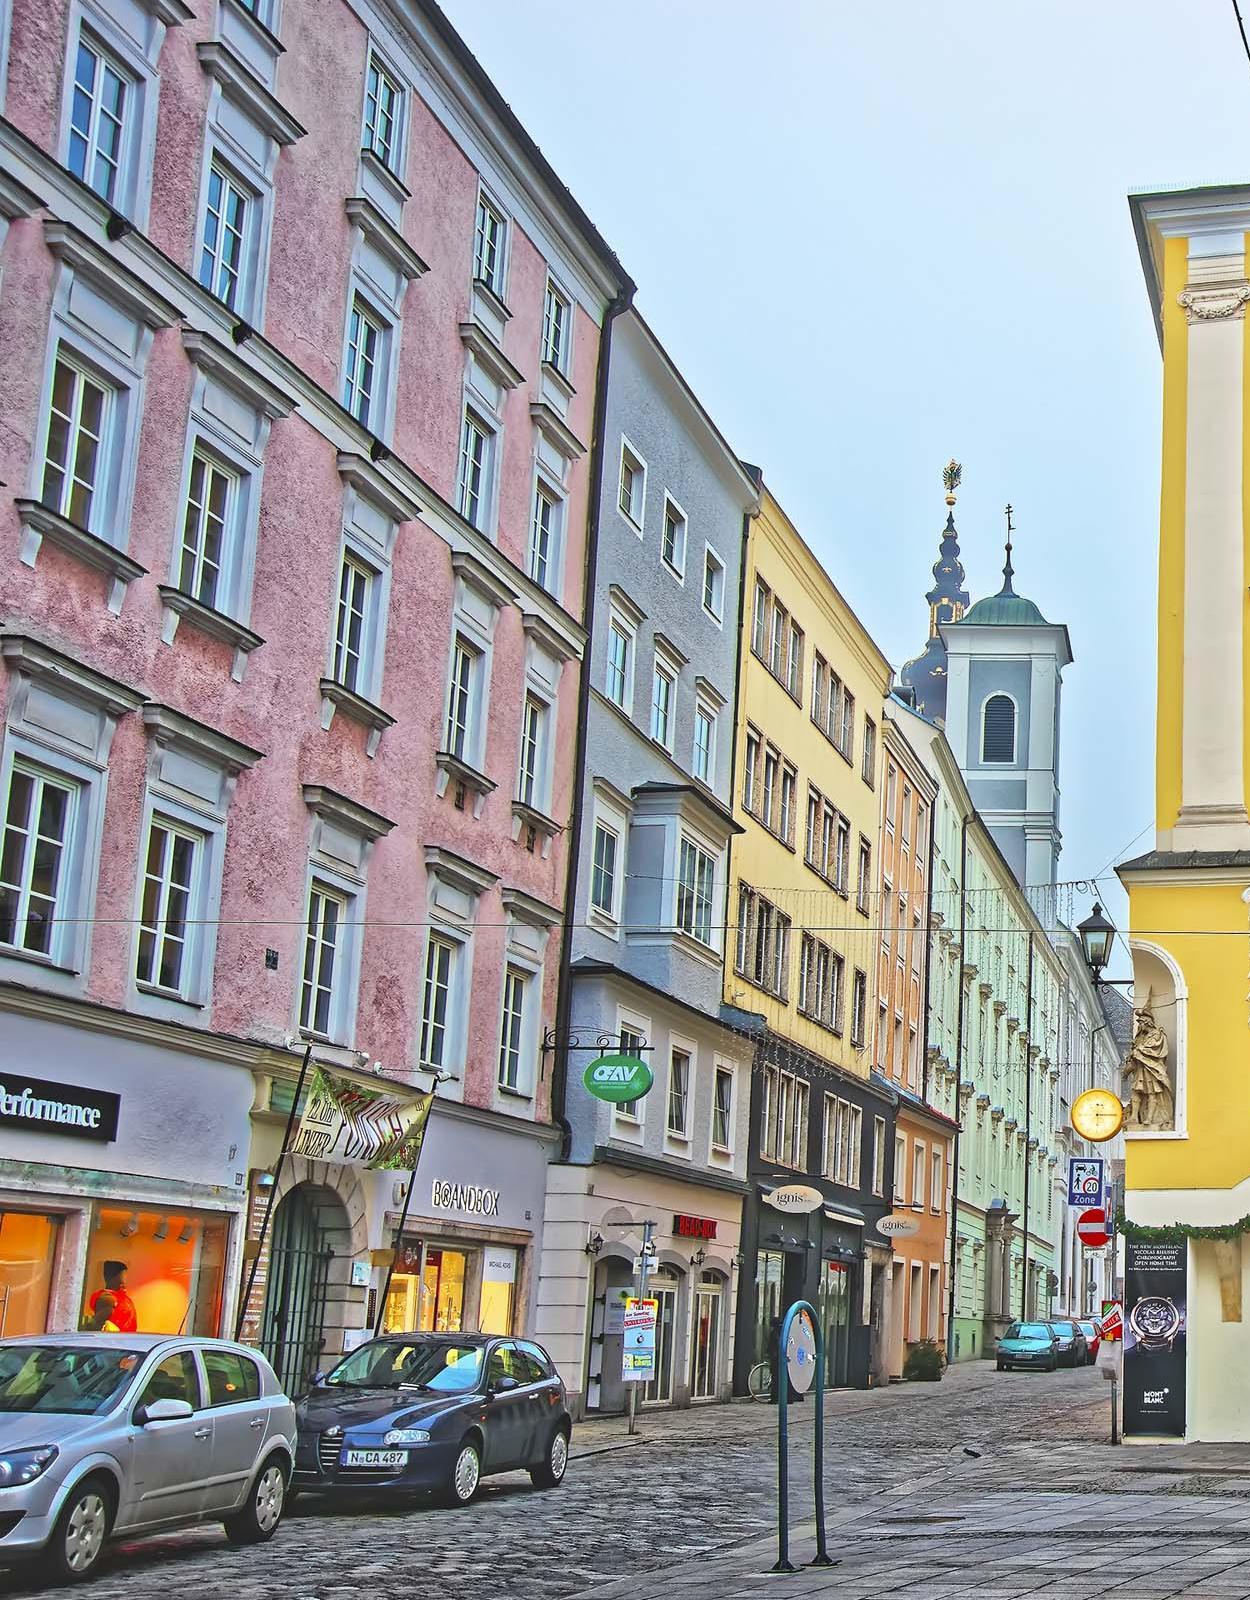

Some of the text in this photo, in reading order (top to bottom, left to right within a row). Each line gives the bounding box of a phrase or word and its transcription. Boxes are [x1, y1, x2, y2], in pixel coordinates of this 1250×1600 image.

[293, 1127, 332, 1159] LINZER
[1086, 1182, 1098, 1193] 20
[776, 1191, 804, 1206] ignis
[1074, 1195, 1096, 1204] Zone
[882, 1221, 905, 1231] ignis
[351, 1452, 404, 1463] N CA 487
